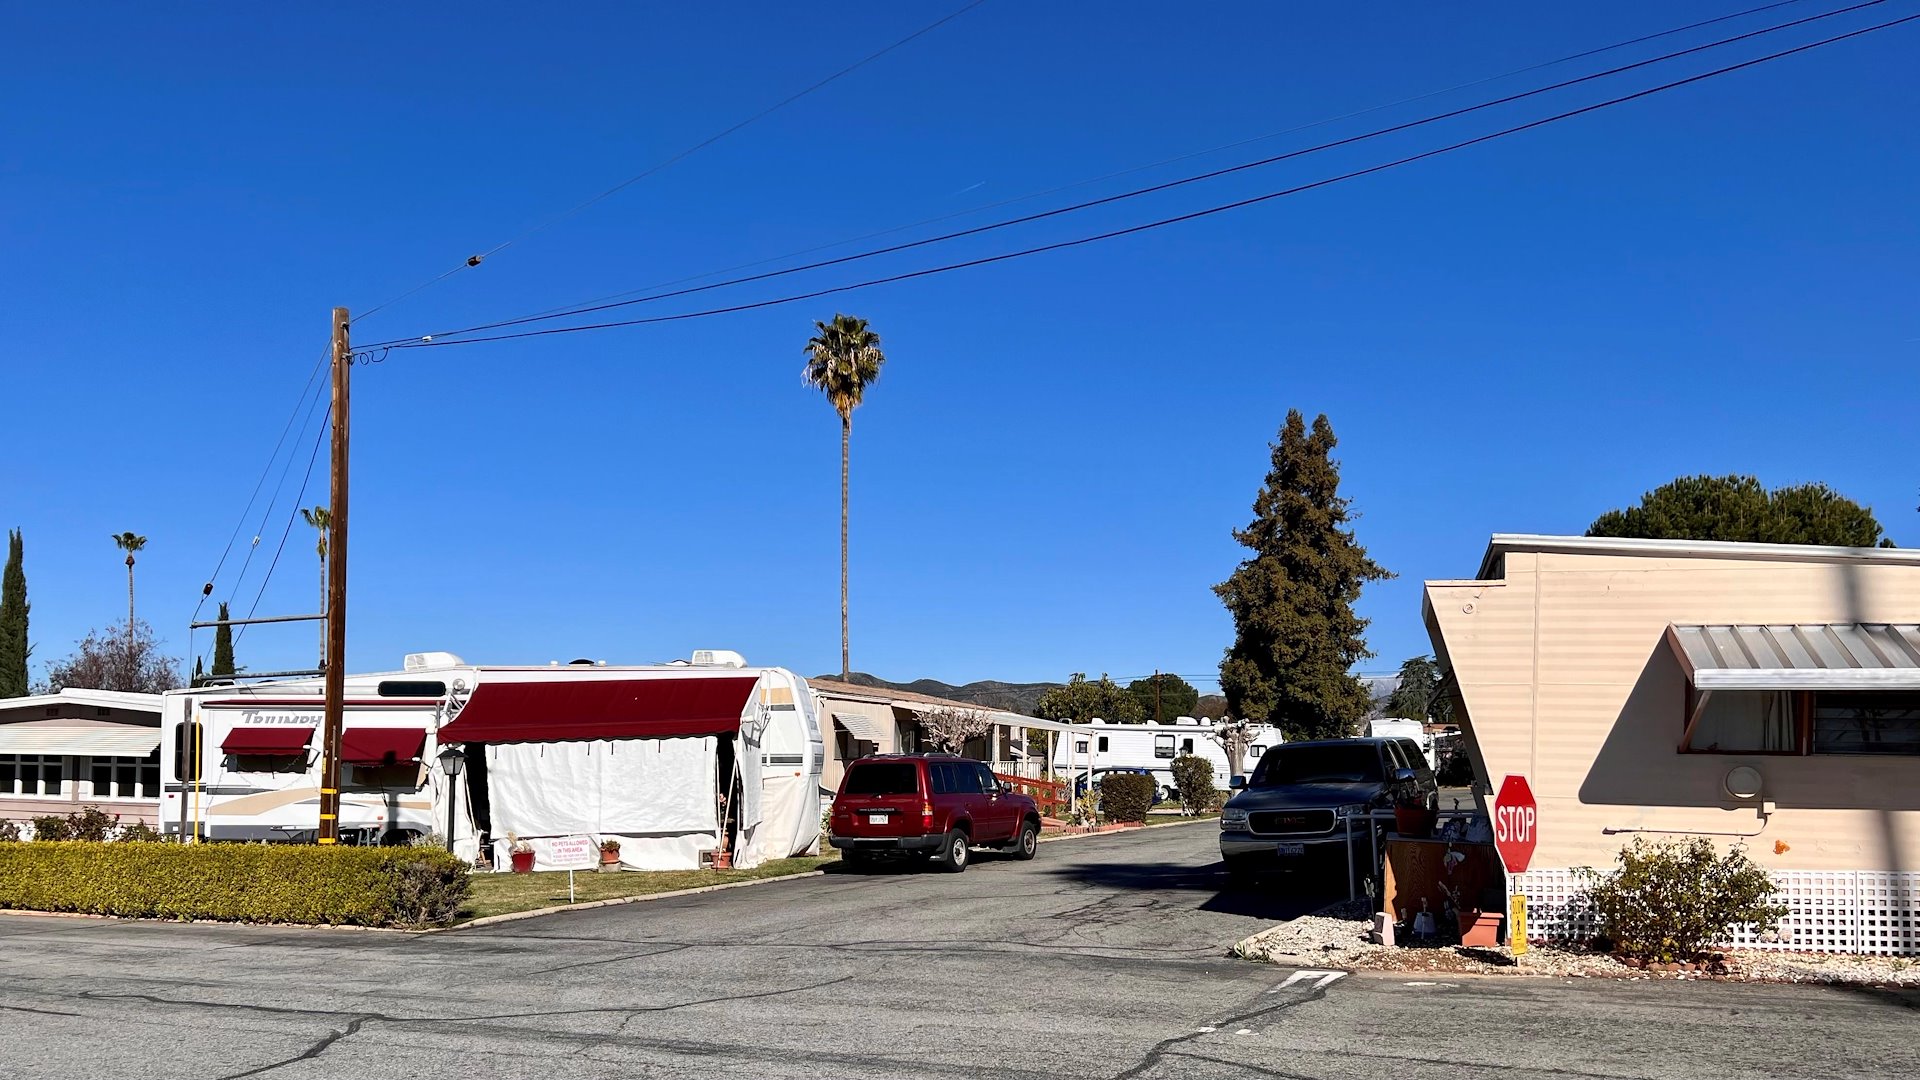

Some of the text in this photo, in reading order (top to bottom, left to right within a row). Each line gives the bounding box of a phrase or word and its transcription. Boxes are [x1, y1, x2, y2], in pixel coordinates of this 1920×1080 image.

[1274, 816, 1306, 825] GMC
[1498, 805, 1535, 843] STOP
[1512, 900, 1525, 914] SLOW
